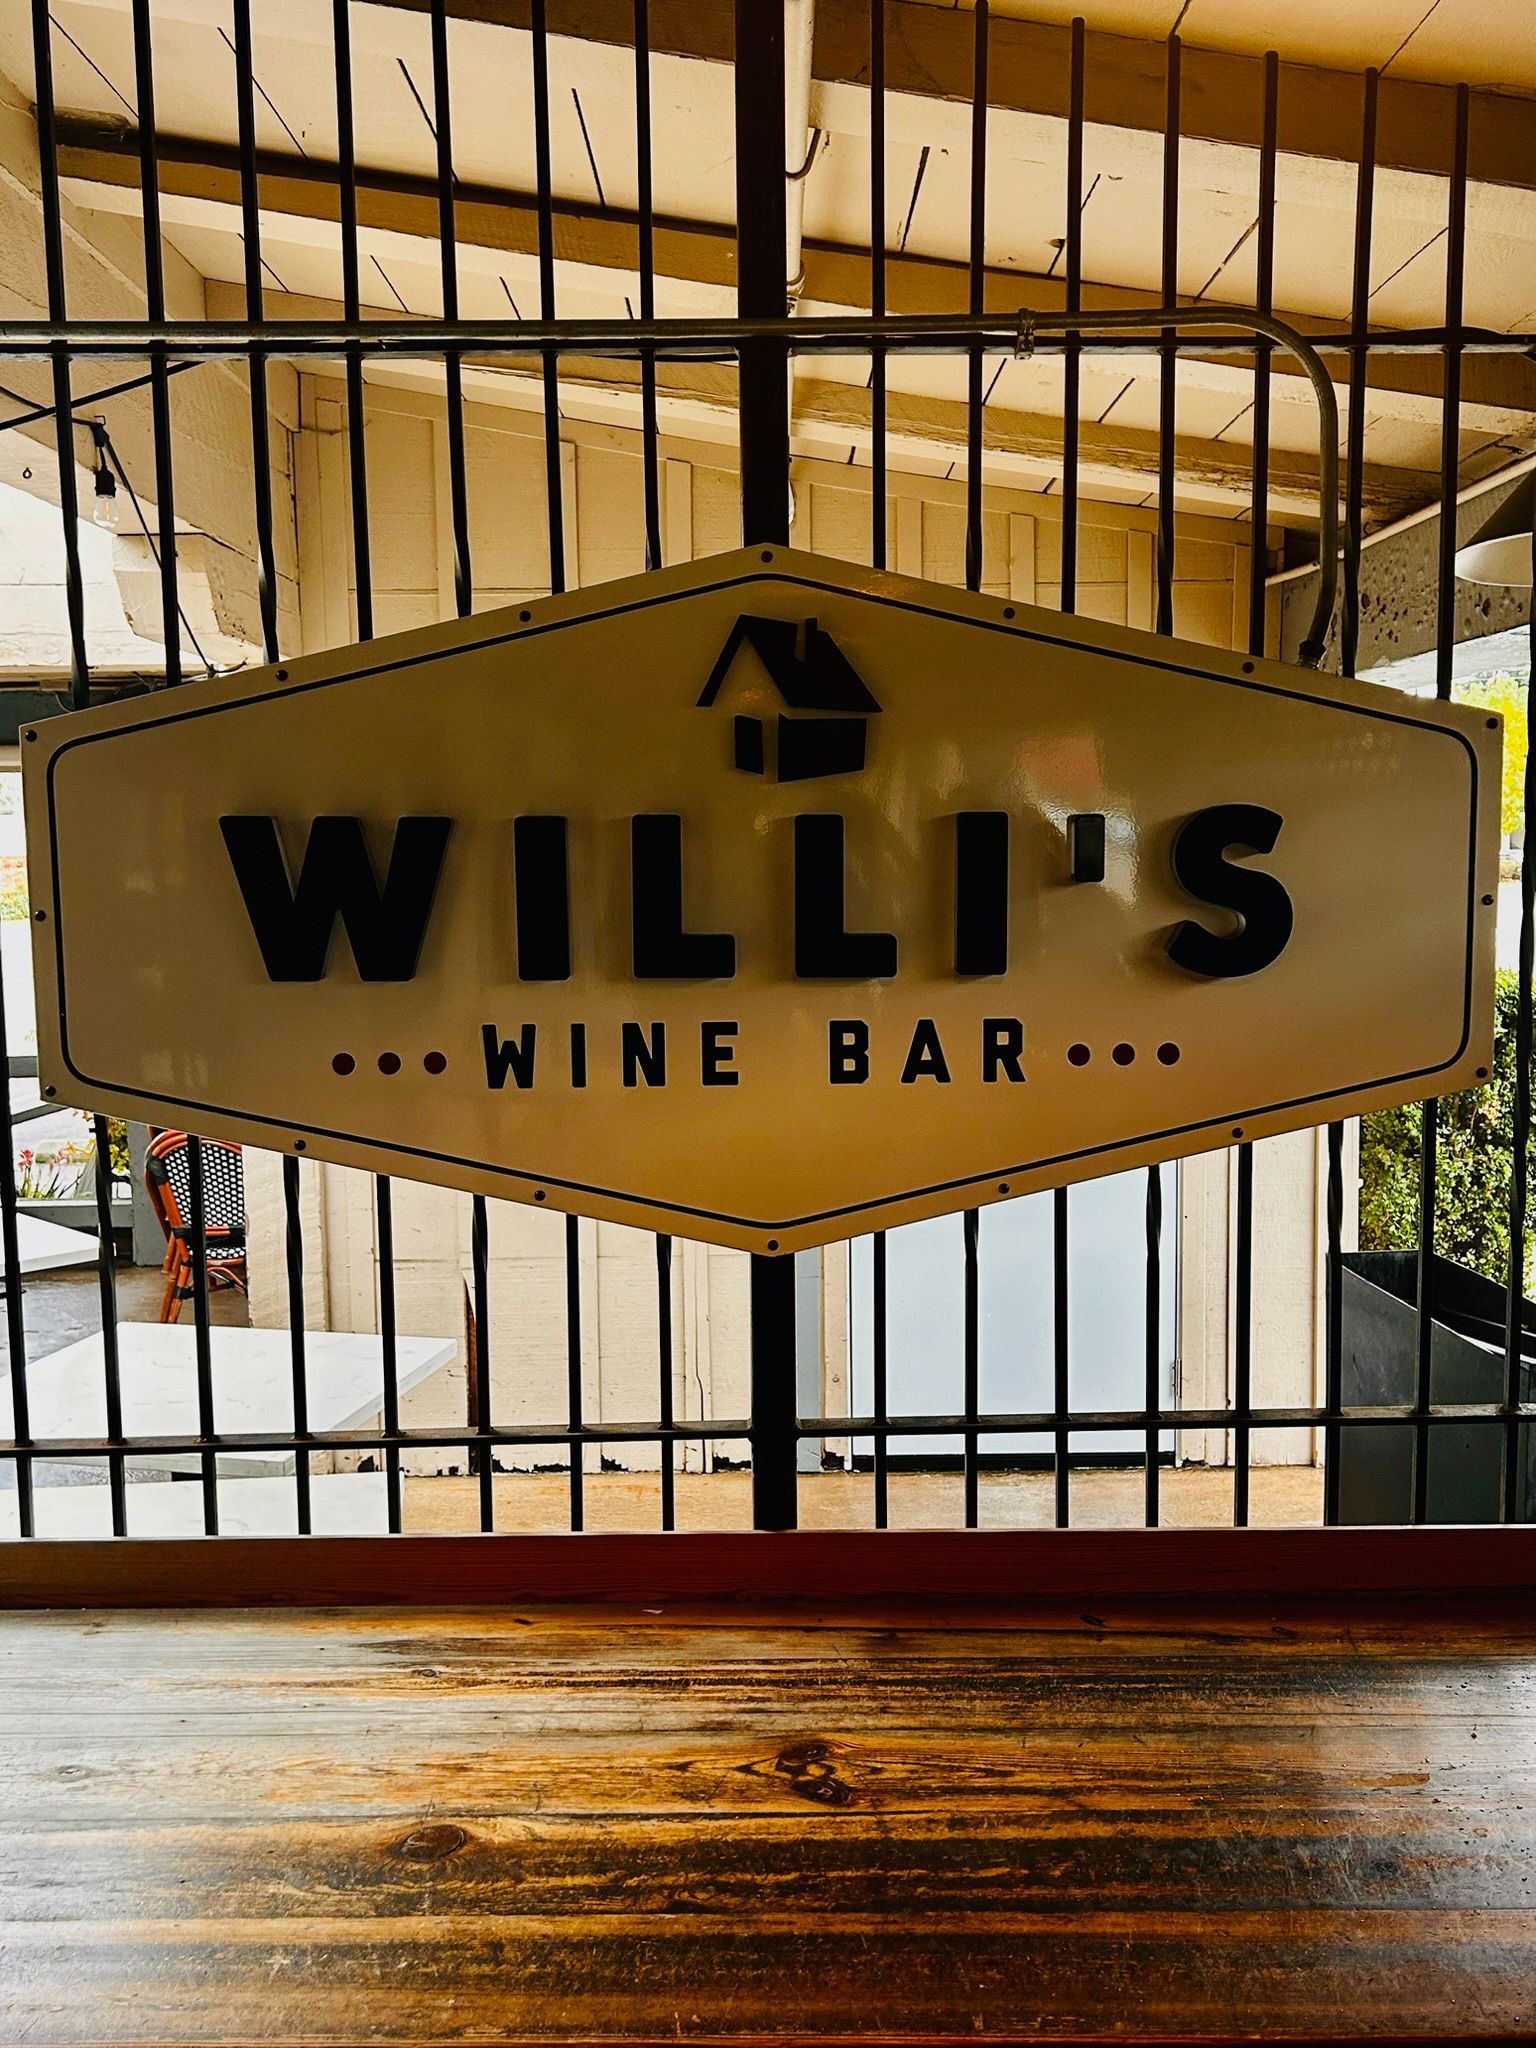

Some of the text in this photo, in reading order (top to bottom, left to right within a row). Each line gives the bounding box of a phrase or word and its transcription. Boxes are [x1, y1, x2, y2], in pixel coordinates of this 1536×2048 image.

[218, 803, 1294, 982] WILLI'S
[481, 1017, 1027, 1090] WINE BAR
